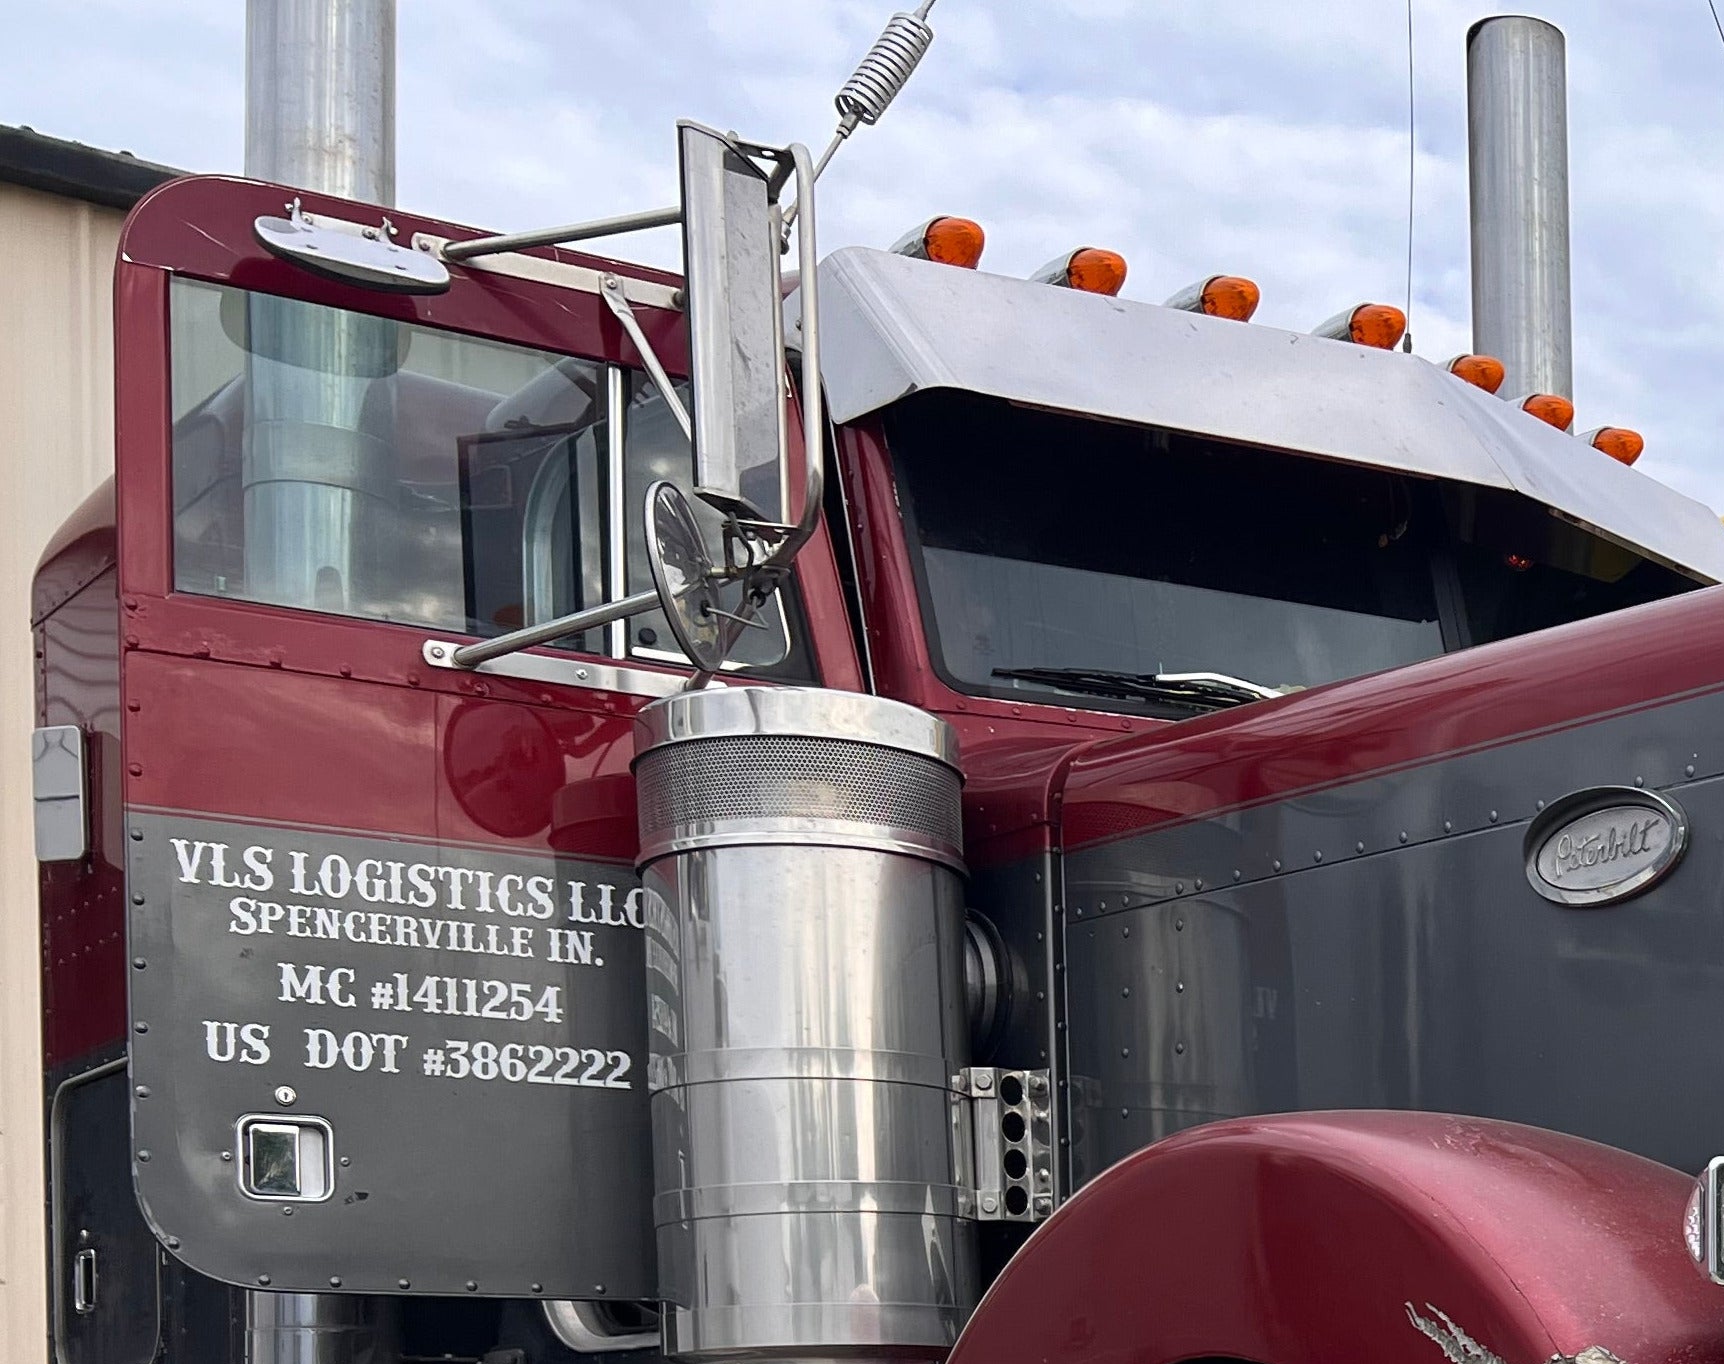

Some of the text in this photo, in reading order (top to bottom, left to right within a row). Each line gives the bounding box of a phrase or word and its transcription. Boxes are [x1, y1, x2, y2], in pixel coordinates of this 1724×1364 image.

[169, 838, 275, 893] VLS
[289, 851, 555, 921] LOGISTICS
[1555, 818, 1660, 880] Peterbilt
[229, 897, 605, 967] SPENCERVILLE IN.
[277, 963, 565, 1024] MC #1411254
[202, 1020, 633, 1089] US DOT #3862222
